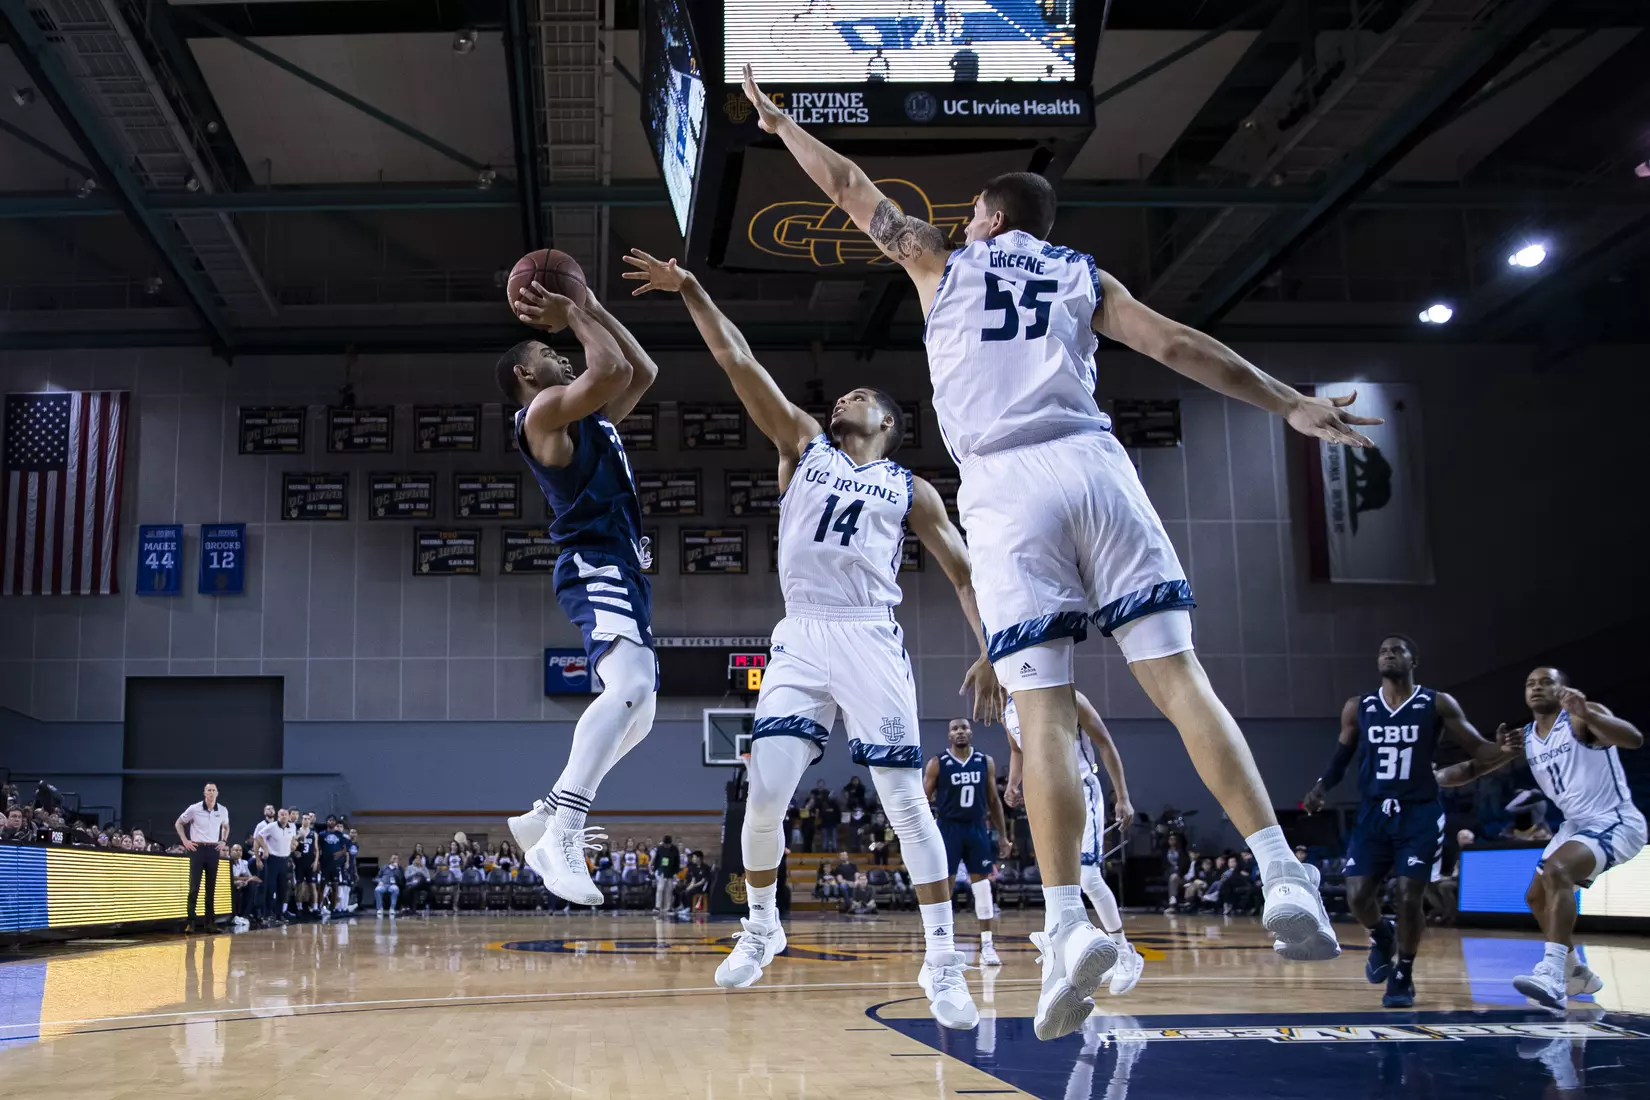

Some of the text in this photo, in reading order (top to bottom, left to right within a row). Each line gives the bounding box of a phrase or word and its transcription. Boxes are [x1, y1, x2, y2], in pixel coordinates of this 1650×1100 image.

[766, 92, 864, 108] C IRVINE
[943, 99, 971, 115] UC
[973, 99, 1020, 115] Irvine
[1023, 99, 1081, 115] Health
[990, 250, 1045, 275] GREENE
[980, 271, 1058, 341] 55
[805, 468, 902, 505] UC IRVINE
[813, 493, 866, 547] 14
[144, 542, 177, 551] MAGEE
[205, 541, 241, 550] BROOKS
[145, 552, 174, 569] 44
[209, 551, 235, 569] 12
[682, 638, 725, 646] EVENTS
[549, 655, 588, 668] PEPSI
[747, 668, 762, 690] 8
[1367, 725, 1420, 744] CBU
[1375, 746, 1414, 780] 31
[950, 770, 982, 786] CBU
[1547, 762, 1566, 795] 11
[959, 785, 976, 808] 0
[303, 843, 310, 854] 3
